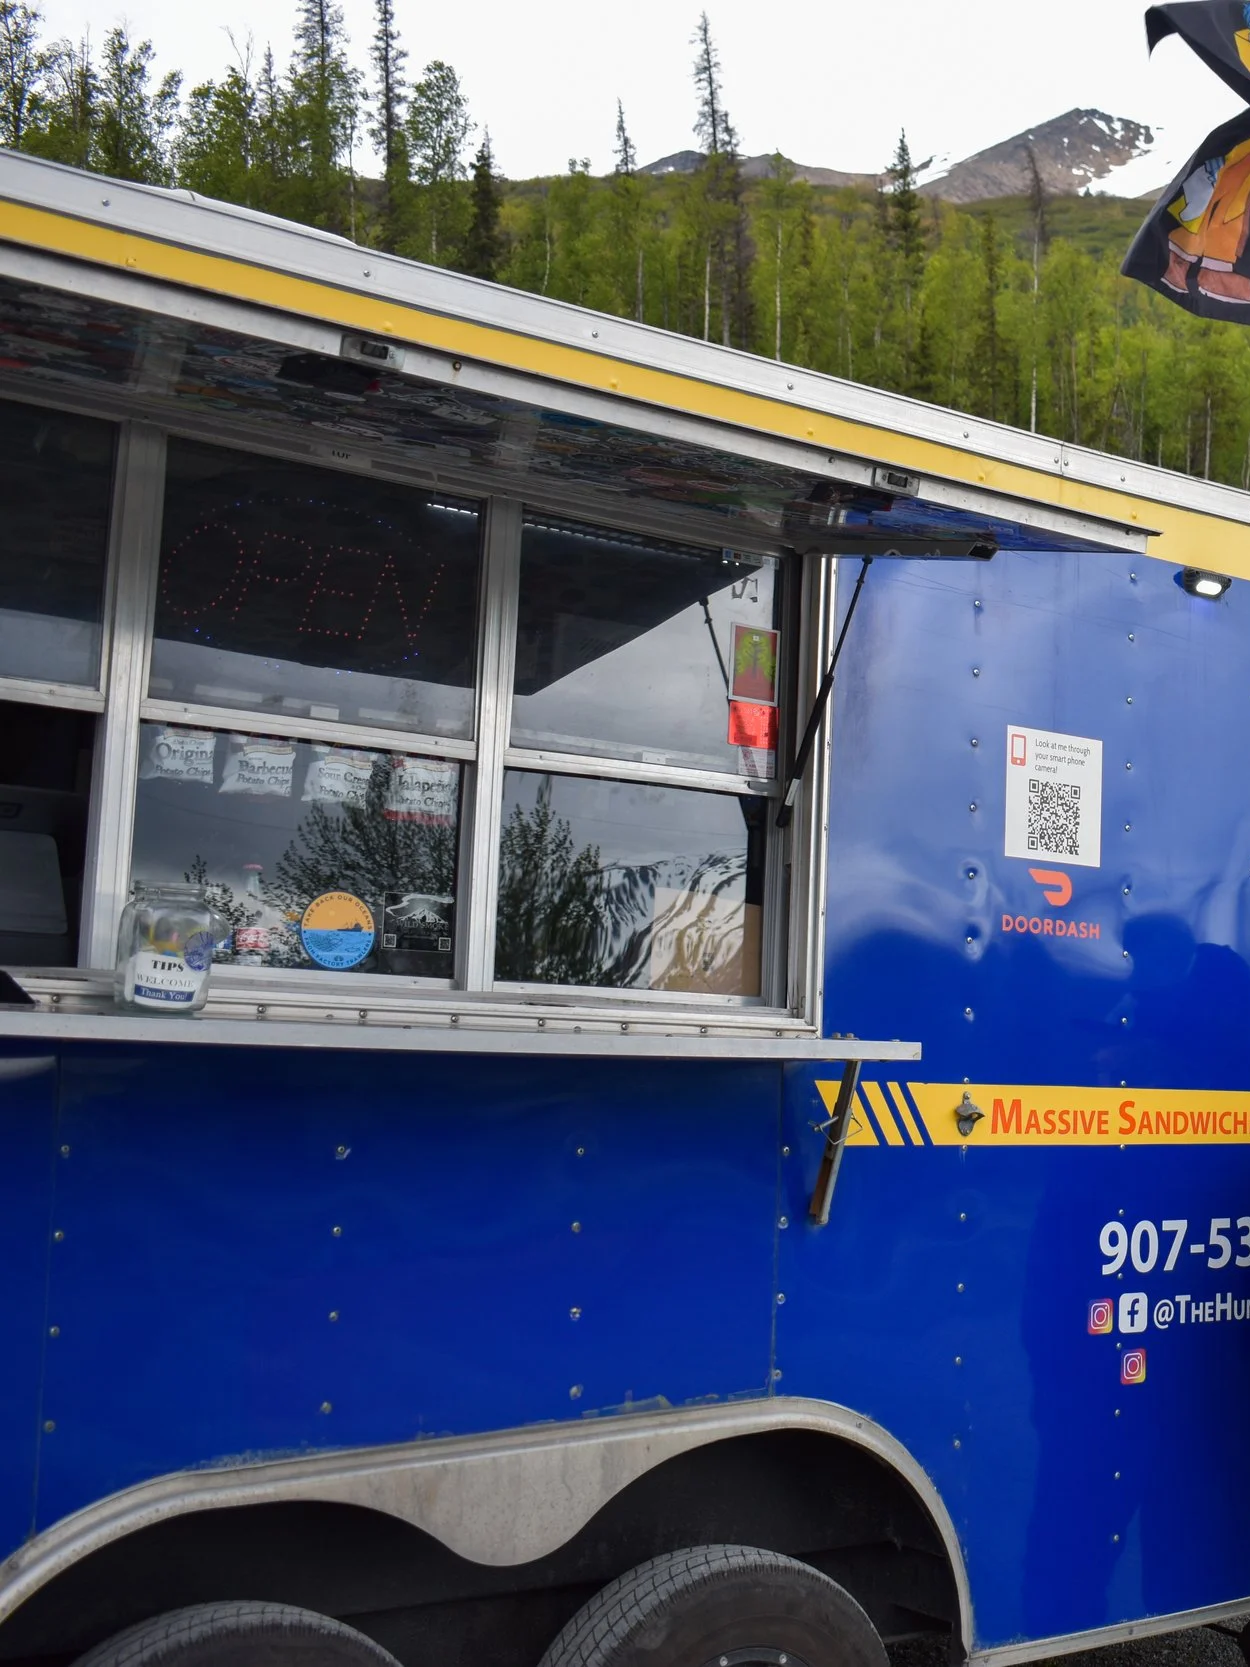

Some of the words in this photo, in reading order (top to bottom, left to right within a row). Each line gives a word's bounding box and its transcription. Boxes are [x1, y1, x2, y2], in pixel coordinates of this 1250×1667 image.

[162, 523, 445, 646] OPEN
[1035, 738, 1049, 748] Look
[1068, 744, 1090, 757] through
[1050, 755, 1066, 763] smart
[1067, 756, 1085, 766] phone
[156, 764, 183, 776] Potato
[318, 767, 341, 781] Sour
[237, 773, 264, 785] Potato
[320, 785, 343, 798] Potato
[303, 908, 314, 926] TAKE
[316, 895, 333, 907] BACK
[355, 901, 372, 929] OCEANS
[396, 919, 418, 928] WILD
[1002, 914, 1099, 939] DOORDASH
[304, 937, 315, 955] FROM
[315, 954, 344, 967] FACTORY
[152, 959, 184, 972] TIPS
[137, 974, 194, 988] WELCOME
[140, 987, 166, 999] Thank
